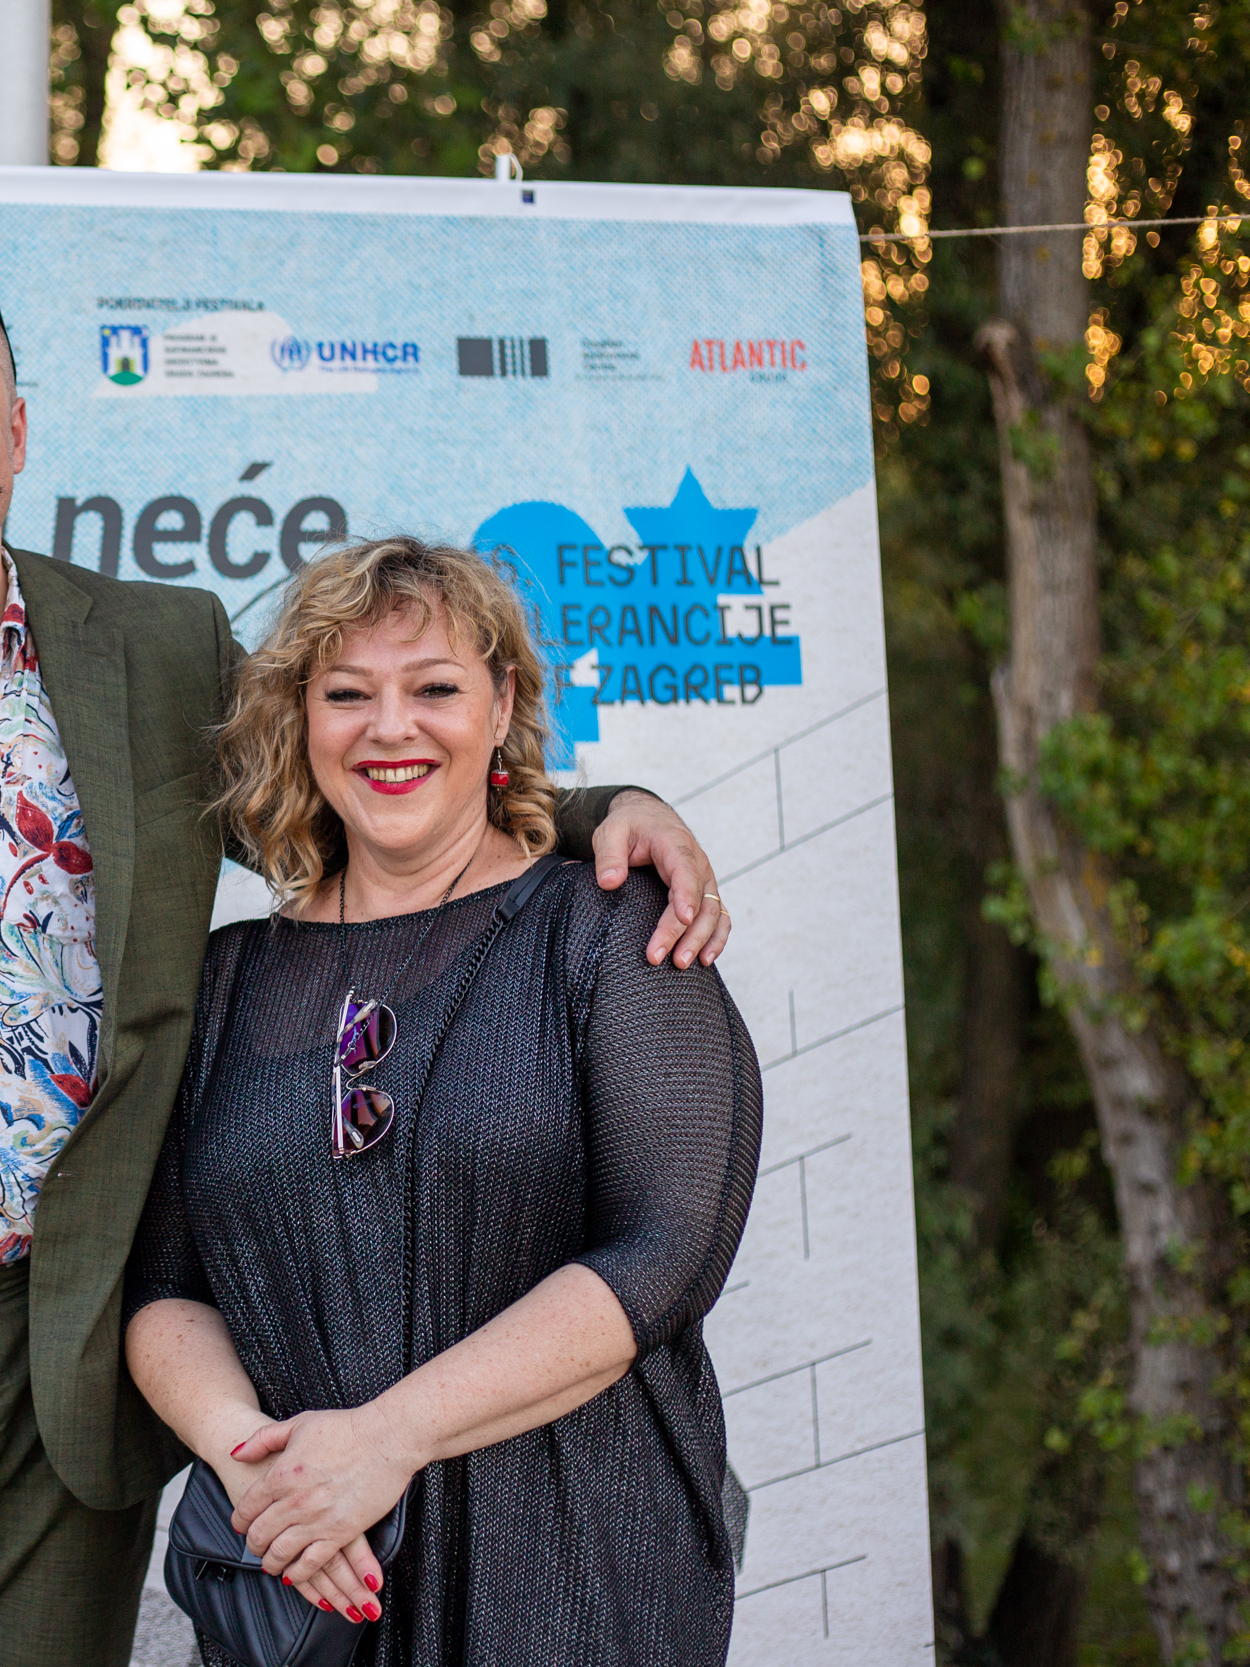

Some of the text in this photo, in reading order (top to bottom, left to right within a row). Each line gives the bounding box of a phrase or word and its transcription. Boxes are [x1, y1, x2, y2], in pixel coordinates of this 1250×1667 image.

[317, 341, 420, 363] UNHCR
[690, 339, 807, 373] ATLANTIC
[52, 460, 348, 579] neće
[557, 544, 781, 588] FESTIVAL
[590, 664, 764, 706] ZAGREB
